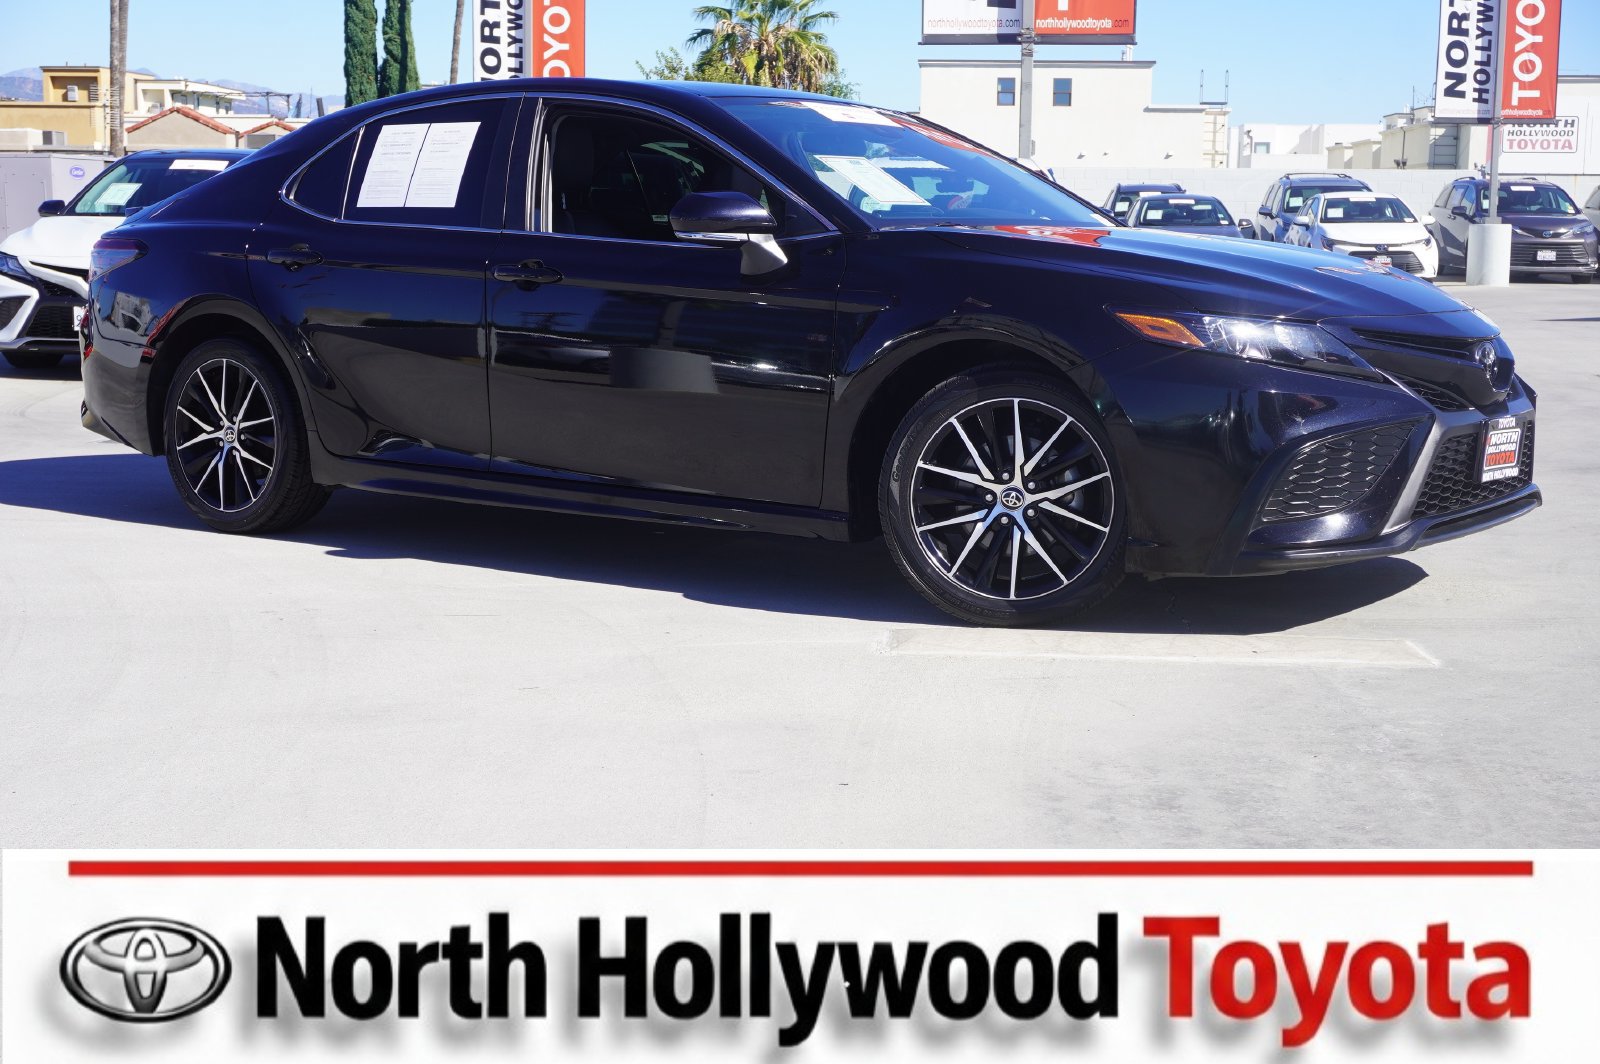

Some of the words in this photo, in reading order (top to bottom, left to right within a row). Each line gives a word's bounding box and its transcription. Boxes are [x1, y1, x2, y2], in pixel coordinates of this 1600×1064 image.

[480, 0, 501, 81] ORT
[507, 0, 524, 79] LLYWO
[1472, 0, 1495, 104] HOLLYW
[1507, 129, 1574, 137] HOLLYWOOD
[1506, 138, 1573, 150] TOYOTA
[1490, 432, 1519, 446] NORTH
[1486, 451, 1515, 466] TOYOTA
